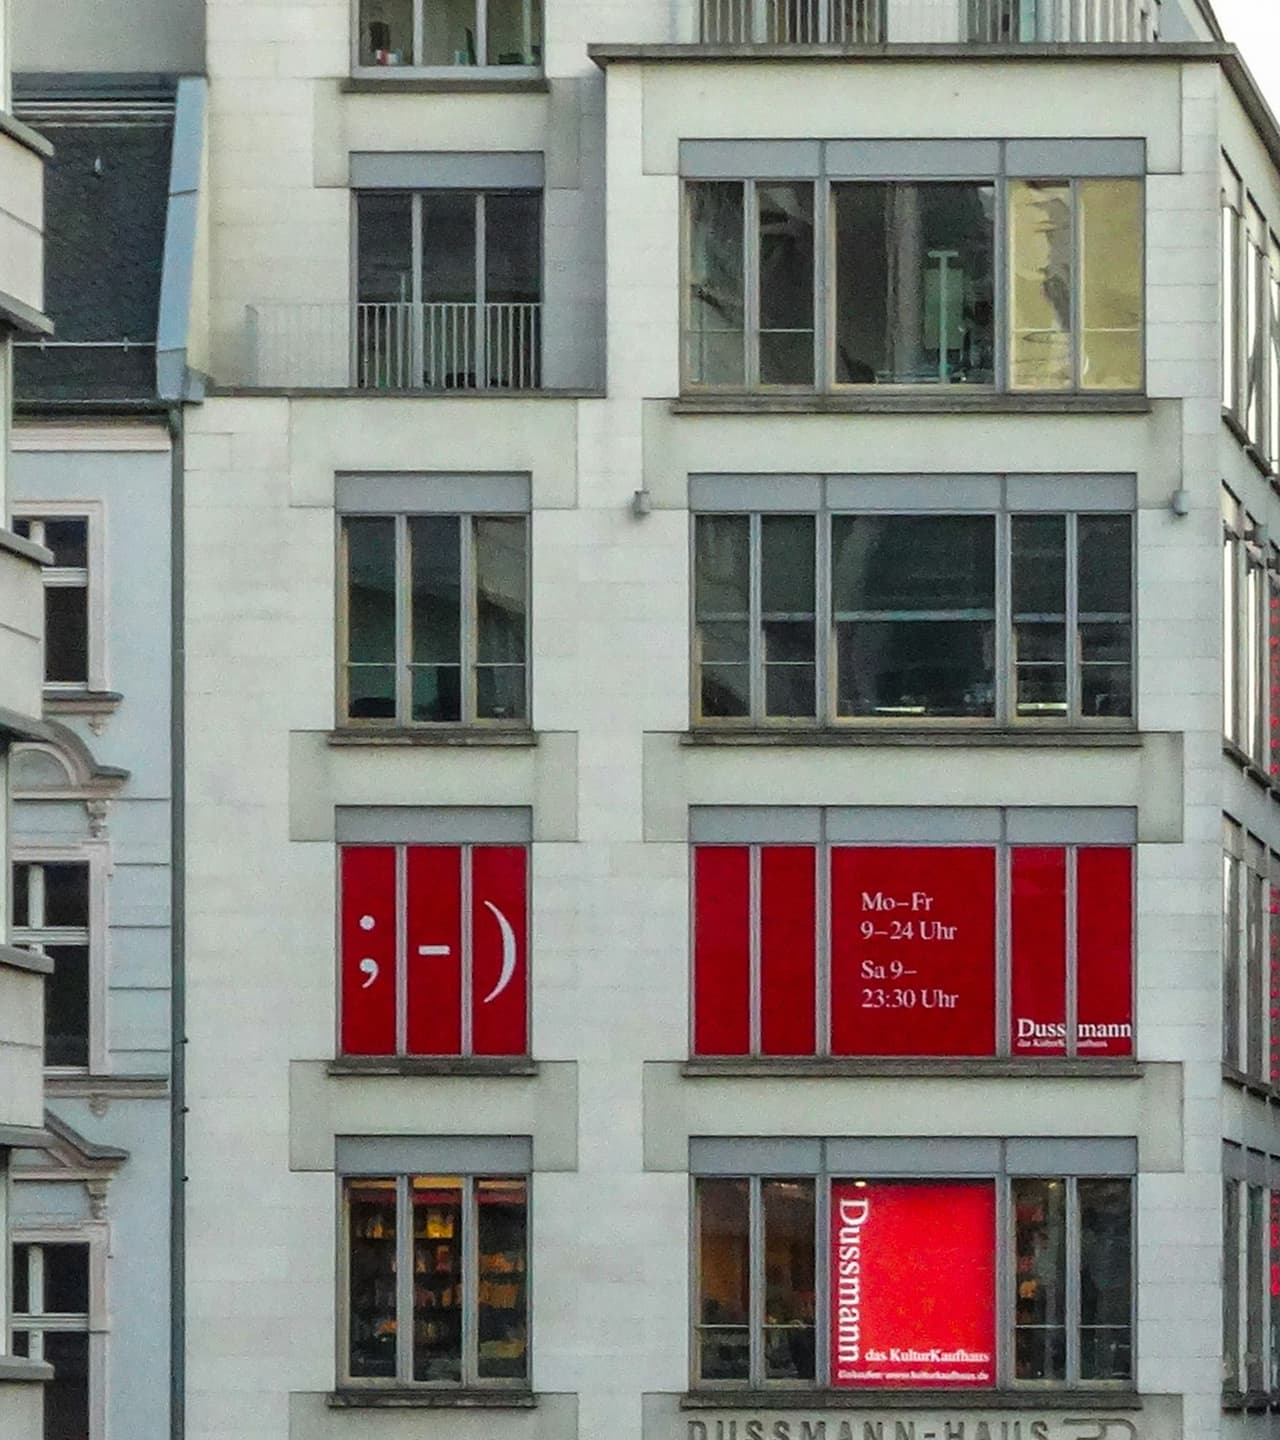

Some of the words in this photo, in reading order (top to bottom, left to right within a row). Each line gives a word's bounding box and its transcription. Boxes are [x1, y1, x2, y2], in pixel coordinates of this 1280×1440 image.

[920, 919, 958, 941] Uhr
[860, 959, 886, 980] Sa
[860, 988, 917, 1008] 23:30
[921, 988, 960, 1009] Uhr
[1016, 1017, 1133, 1038] Dussmann
[838, 1197, 869, 1362] Dussmann
[864, 1349, 887, 1363] das
